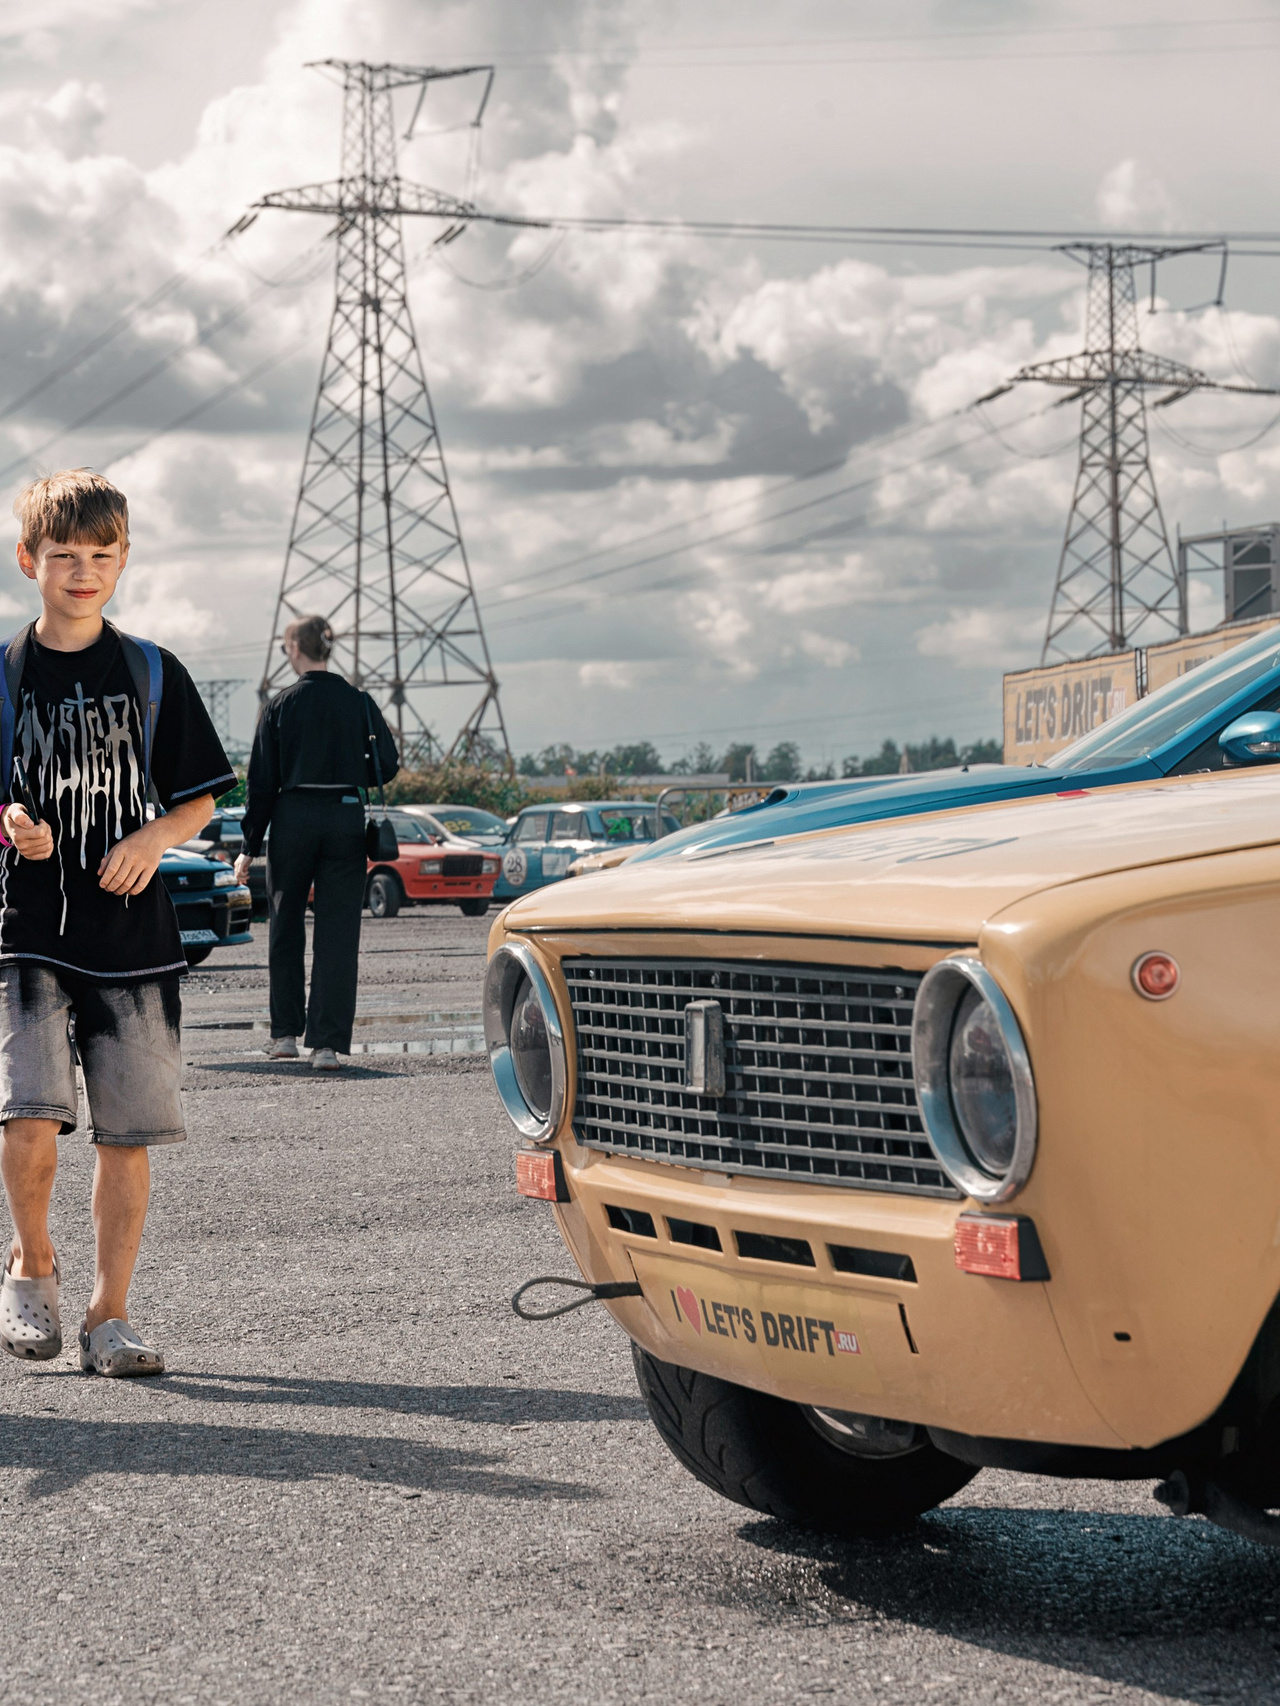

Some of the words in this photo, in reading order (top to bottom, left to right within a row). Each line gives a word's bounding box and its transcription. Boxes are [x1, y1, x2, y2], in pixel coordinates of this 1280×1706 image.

[1015, 685, 1057, 743] LET'S
[442, 820, 472, 833] 82
[607, 818, 632, 835] 28
[507, 856, 523, 873] 28
[671, 1289, 682, 1323] I
[701, 1298, 757, 1344] LET'S
